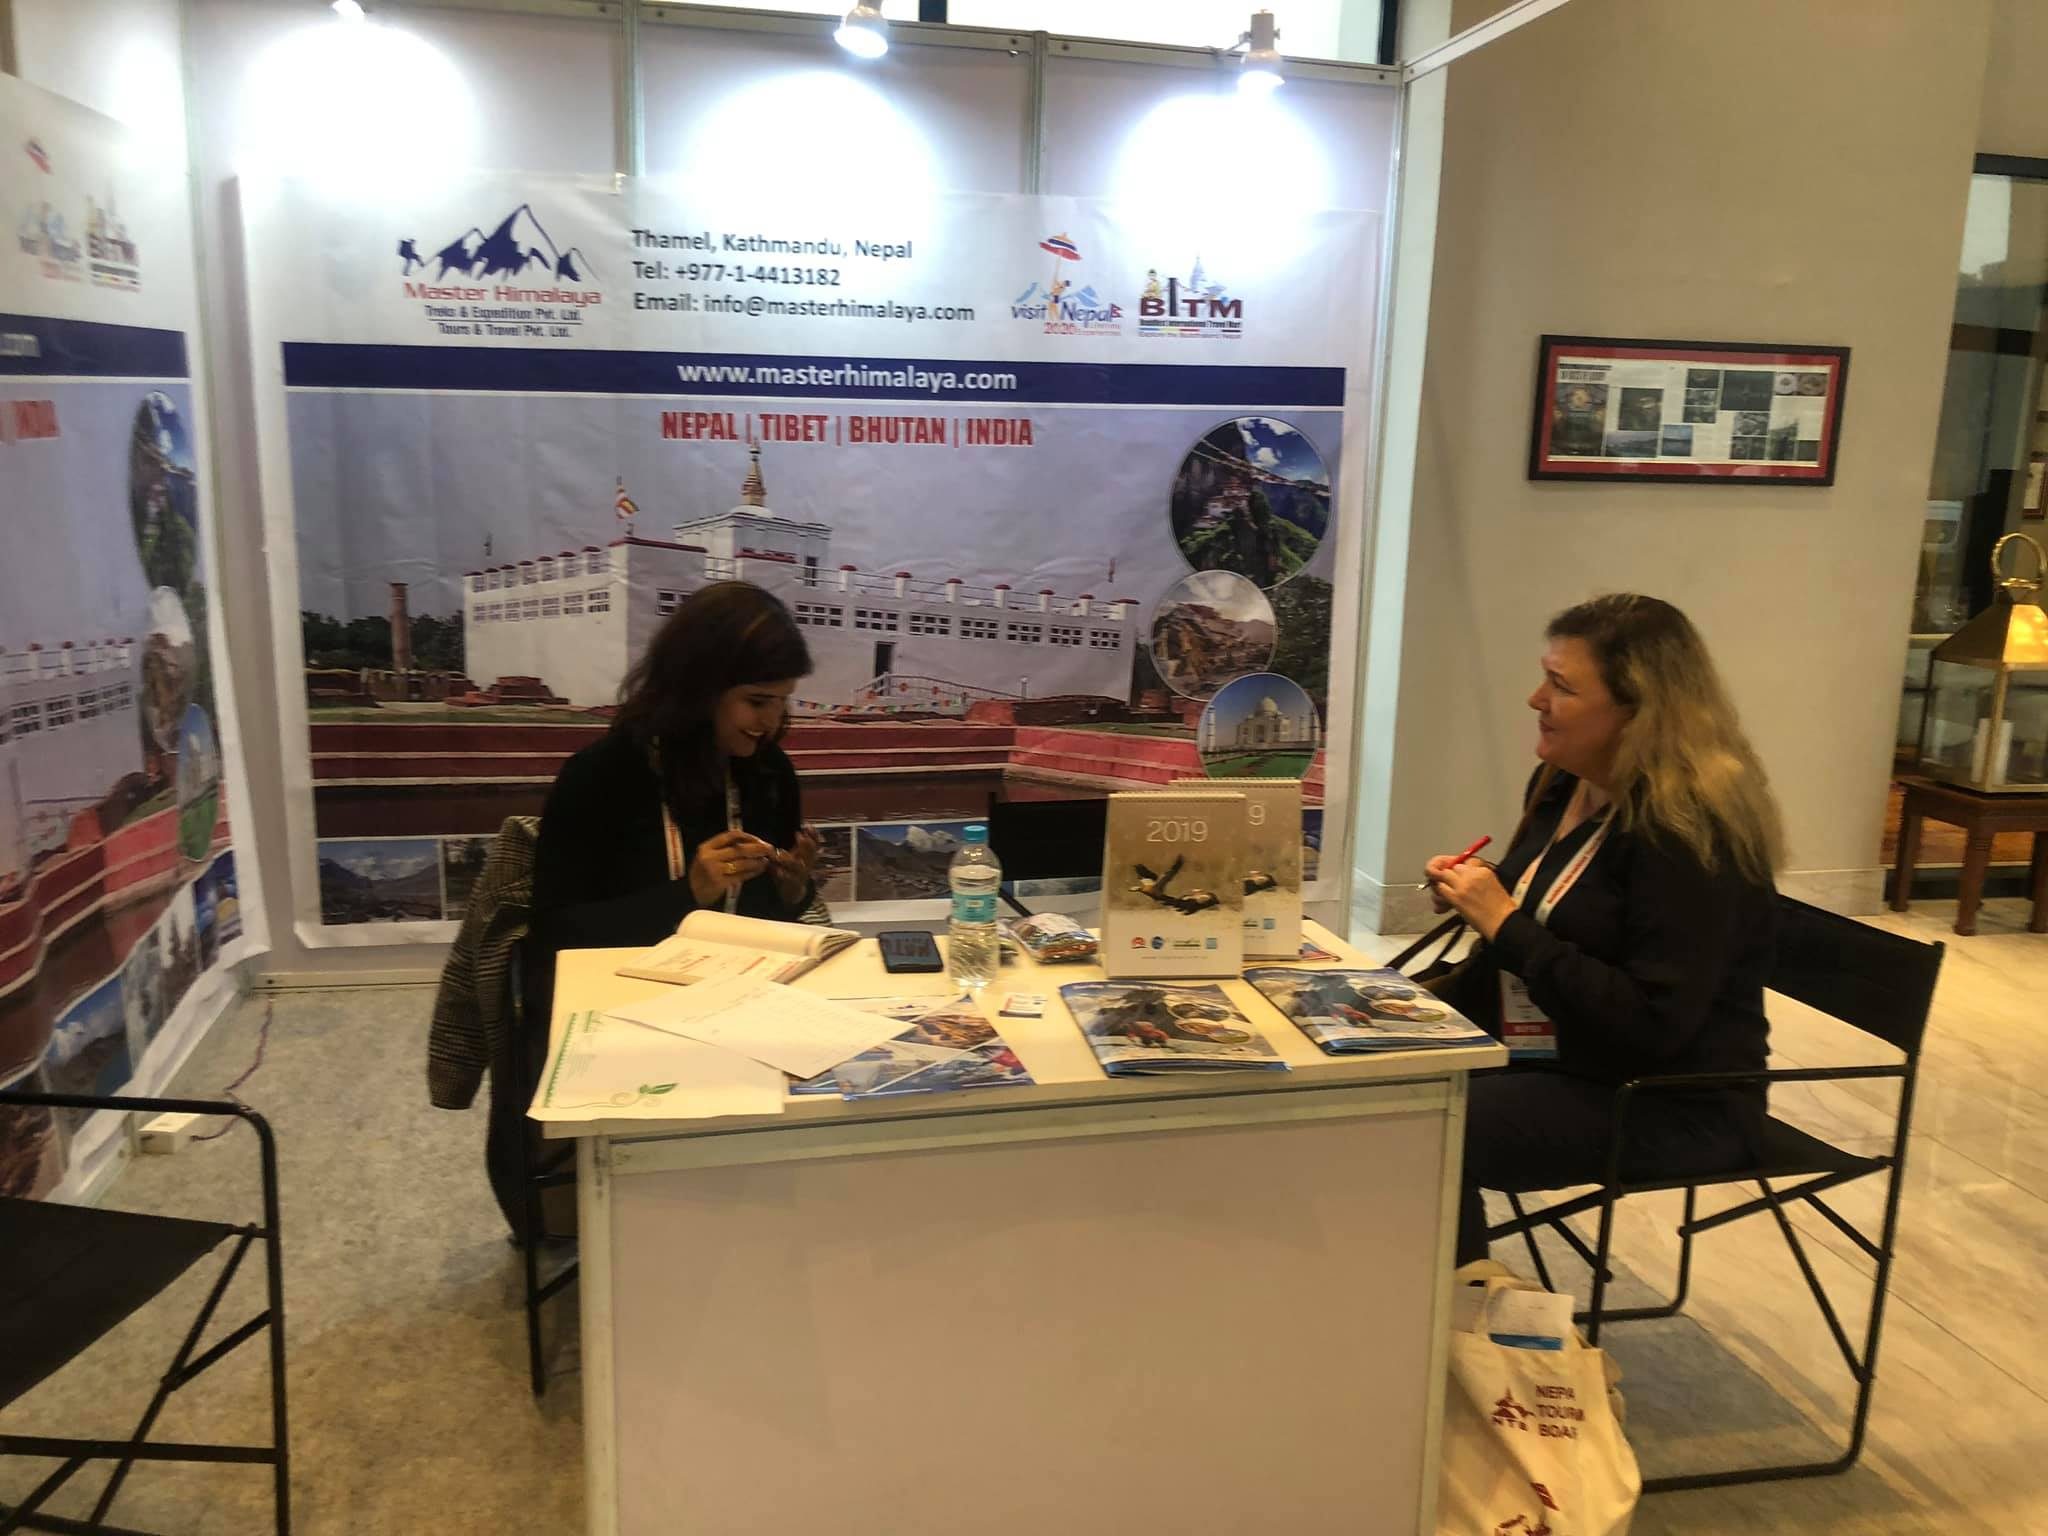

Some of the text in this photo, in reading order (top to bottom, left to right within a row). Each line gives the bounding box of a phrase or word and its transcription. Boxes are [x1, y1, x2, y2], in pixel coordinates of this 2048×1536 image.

[631, 229, 912, 261] Thamel, Kathmandu, Nepal
[632, 260, 841, 286] Tel: +977-1-4413182
[402, 282, 602, 308] Master Himalaya
[633, 292, 976, 323] Email: info@masterhimalaya.com
[1139, 278, 1242, 319] BITM
[1060, 301, 1113, 328] Nepal
[677, 365, 1018, 394] www.masterhimalaya.com
[661, 411, 739, 441] NEPAL
[759, 413, 829, 443] TIBET
[848, 416, 946, 445] BHUTAN
[967, 418, 1033, 446] INDIA
[1146, 820, 1208, 842] 2019
[1535, 1385, 1575, 1400] NEPA
